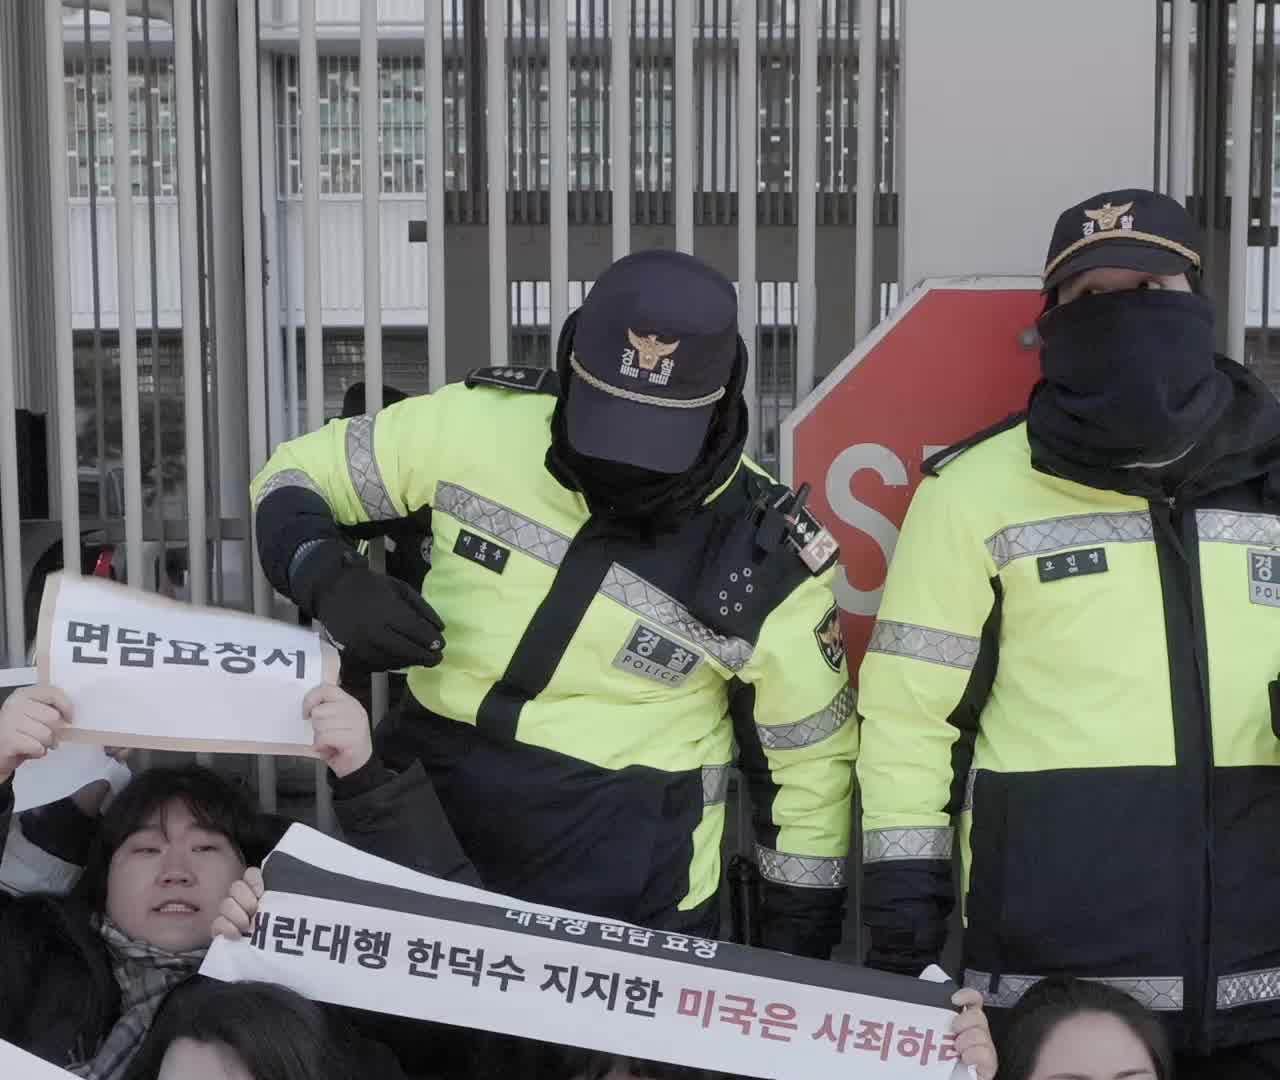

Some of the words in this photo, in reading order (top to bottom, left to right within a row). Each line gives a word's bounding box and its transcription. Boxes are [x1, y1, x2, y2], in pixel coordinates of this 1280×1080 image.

[66, 620, 306, 680] 면담요청서
[623, 654, 680, 681] POLICE
[636, 628, 693, 673] 경찰
[599, 923, 655, 948] 면담
[661, 935, 719, 959] 요청
[405, 938, 526, 995] 한덕수
[539, 962, 665, 1019] 지지한
[676, 987, 799, 1041] 미국은
